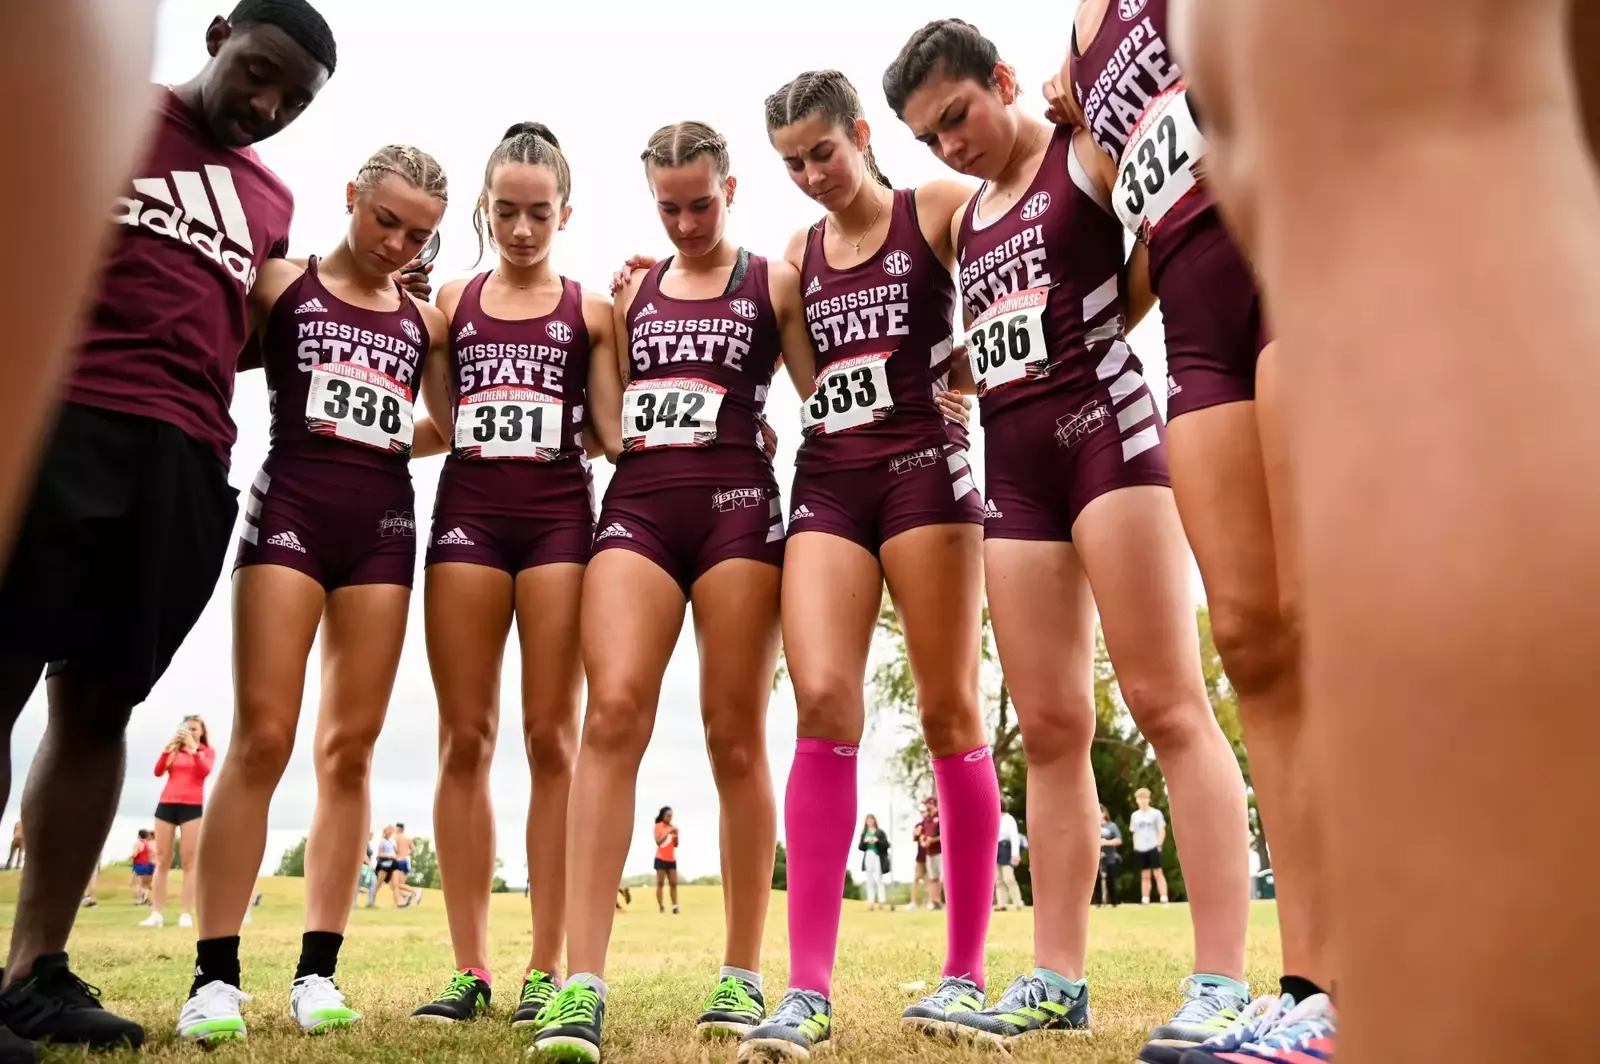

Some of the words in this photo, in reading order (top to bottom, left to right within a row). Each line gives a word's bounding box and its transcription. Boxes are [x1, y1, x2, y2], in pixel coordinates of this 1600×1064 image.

[1121, 115, 1189, 215] 332
[1022, 193, 1048, 219] SEC
[885, 251, 911, 275] SEC
[732, 299, 756, 319] SEC
[806, 283, 909, 323] MISSISSIPPI
[297, 321, 420, 368] MISSISSIPPI
[548, 321, 571, 341] SEC
[631, 318, 754, 343] MISSISSIPPI
[810, 302, 910, 353] STATE
[971, 314, 1031, 375] 336
[297, 338, 415, 384] STATE
[457, 343, 568, 366] MISSISSIPPI
[631, 334, 751, 373] STATE
[322, 362, 368, 382] SOUTHERN
[368, 372, 407, 399] SHOWCASE
[459, 358, 565, 394] STATE
[673, 379, 719, 395] SHOWCASE
[809, 366, 877, 420] 333
[323, 379, 402, 435] 338
[467, 391, 508, 404] SOUTHERN
[509, 389, 555, 403] SHOWCASE
[634, 391, 706, 432] 342
[472, 404, 543, 443] 331
[718, 489, 756, 503] STATE
[267, 537, 306, 554] adidas
[437, 537, 475, 546] adidas
